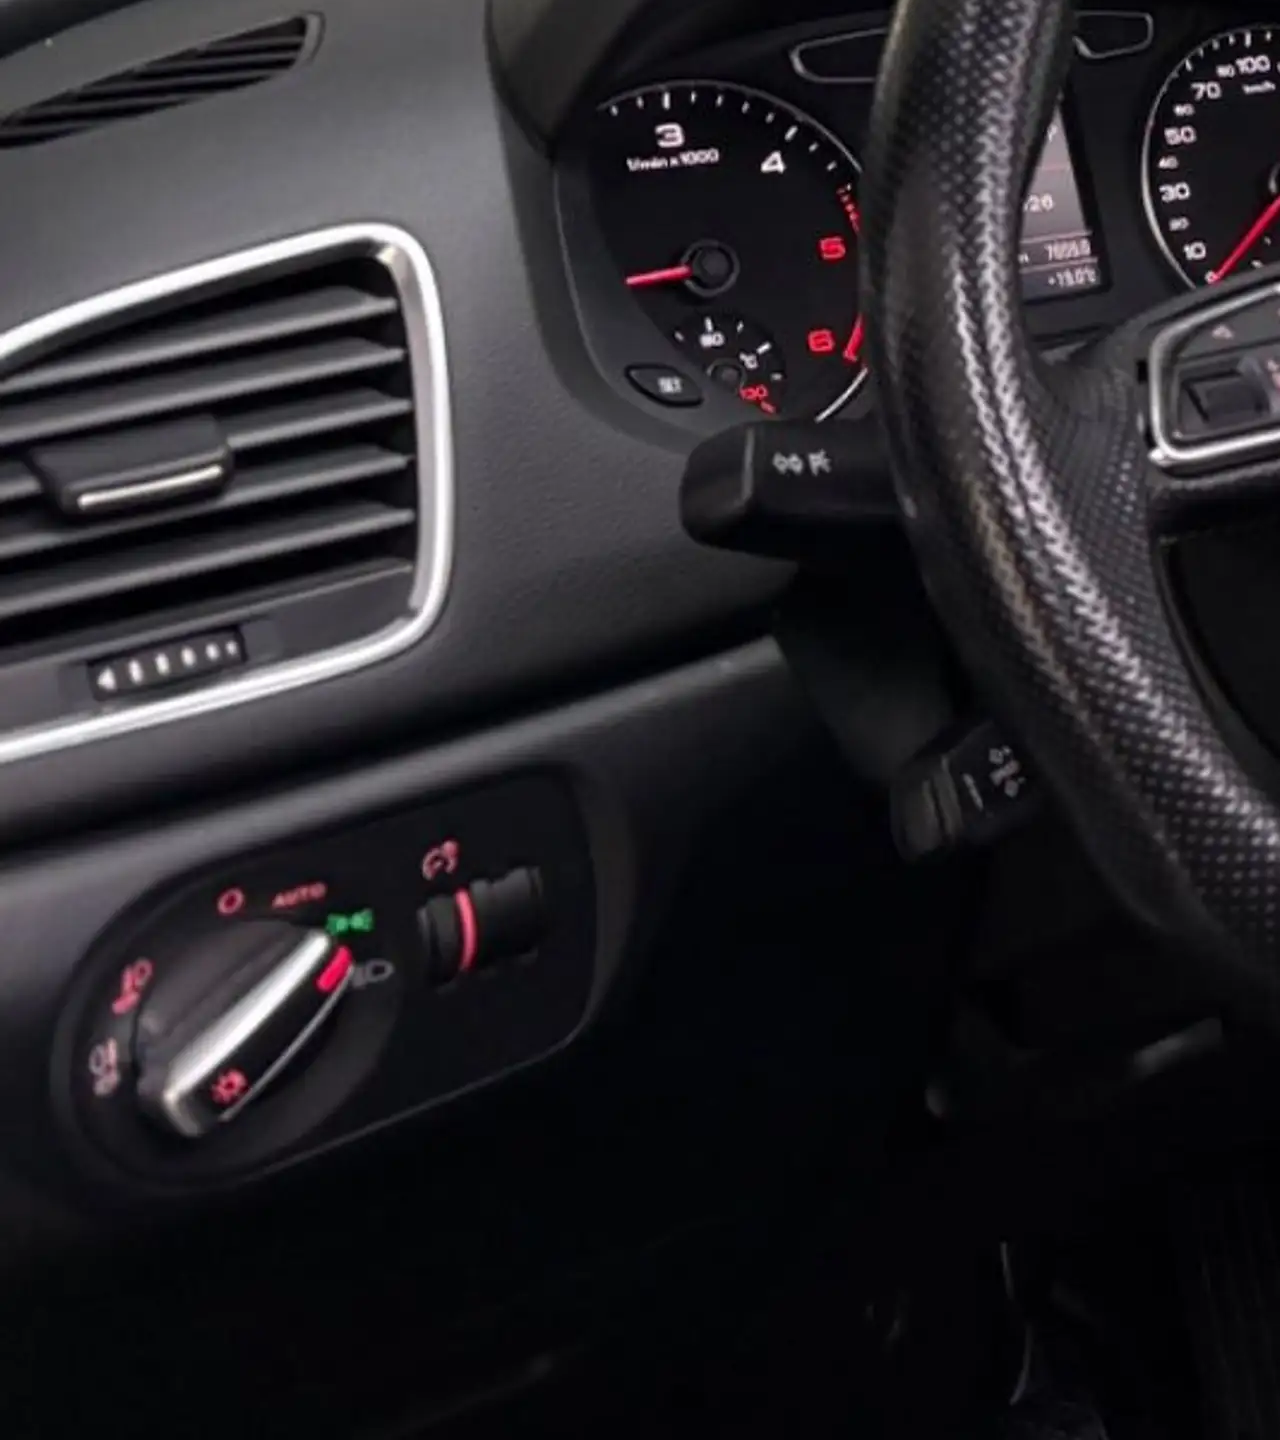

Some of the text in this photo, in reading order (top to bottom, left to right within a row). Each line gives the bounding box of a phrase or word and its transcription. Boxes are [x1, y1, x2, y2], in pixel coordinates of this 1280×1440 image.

[1235, 54, 1272, 74] 100
[1190, 81, 1223, 101] 70
[654, 122, 686, 148] 3
[1163, 125, 1197, 146] 50
[679, 147, 721, 167] 1000
[760, 149, 787, 174] 4
[1158, 181, 1192, 203] 30
[818, 236, 847, 260] 5
[1182, 241, 1208, 261] 10
[806, 328, 836, 353] 6
[271, 882, 331, 910] AUTO
